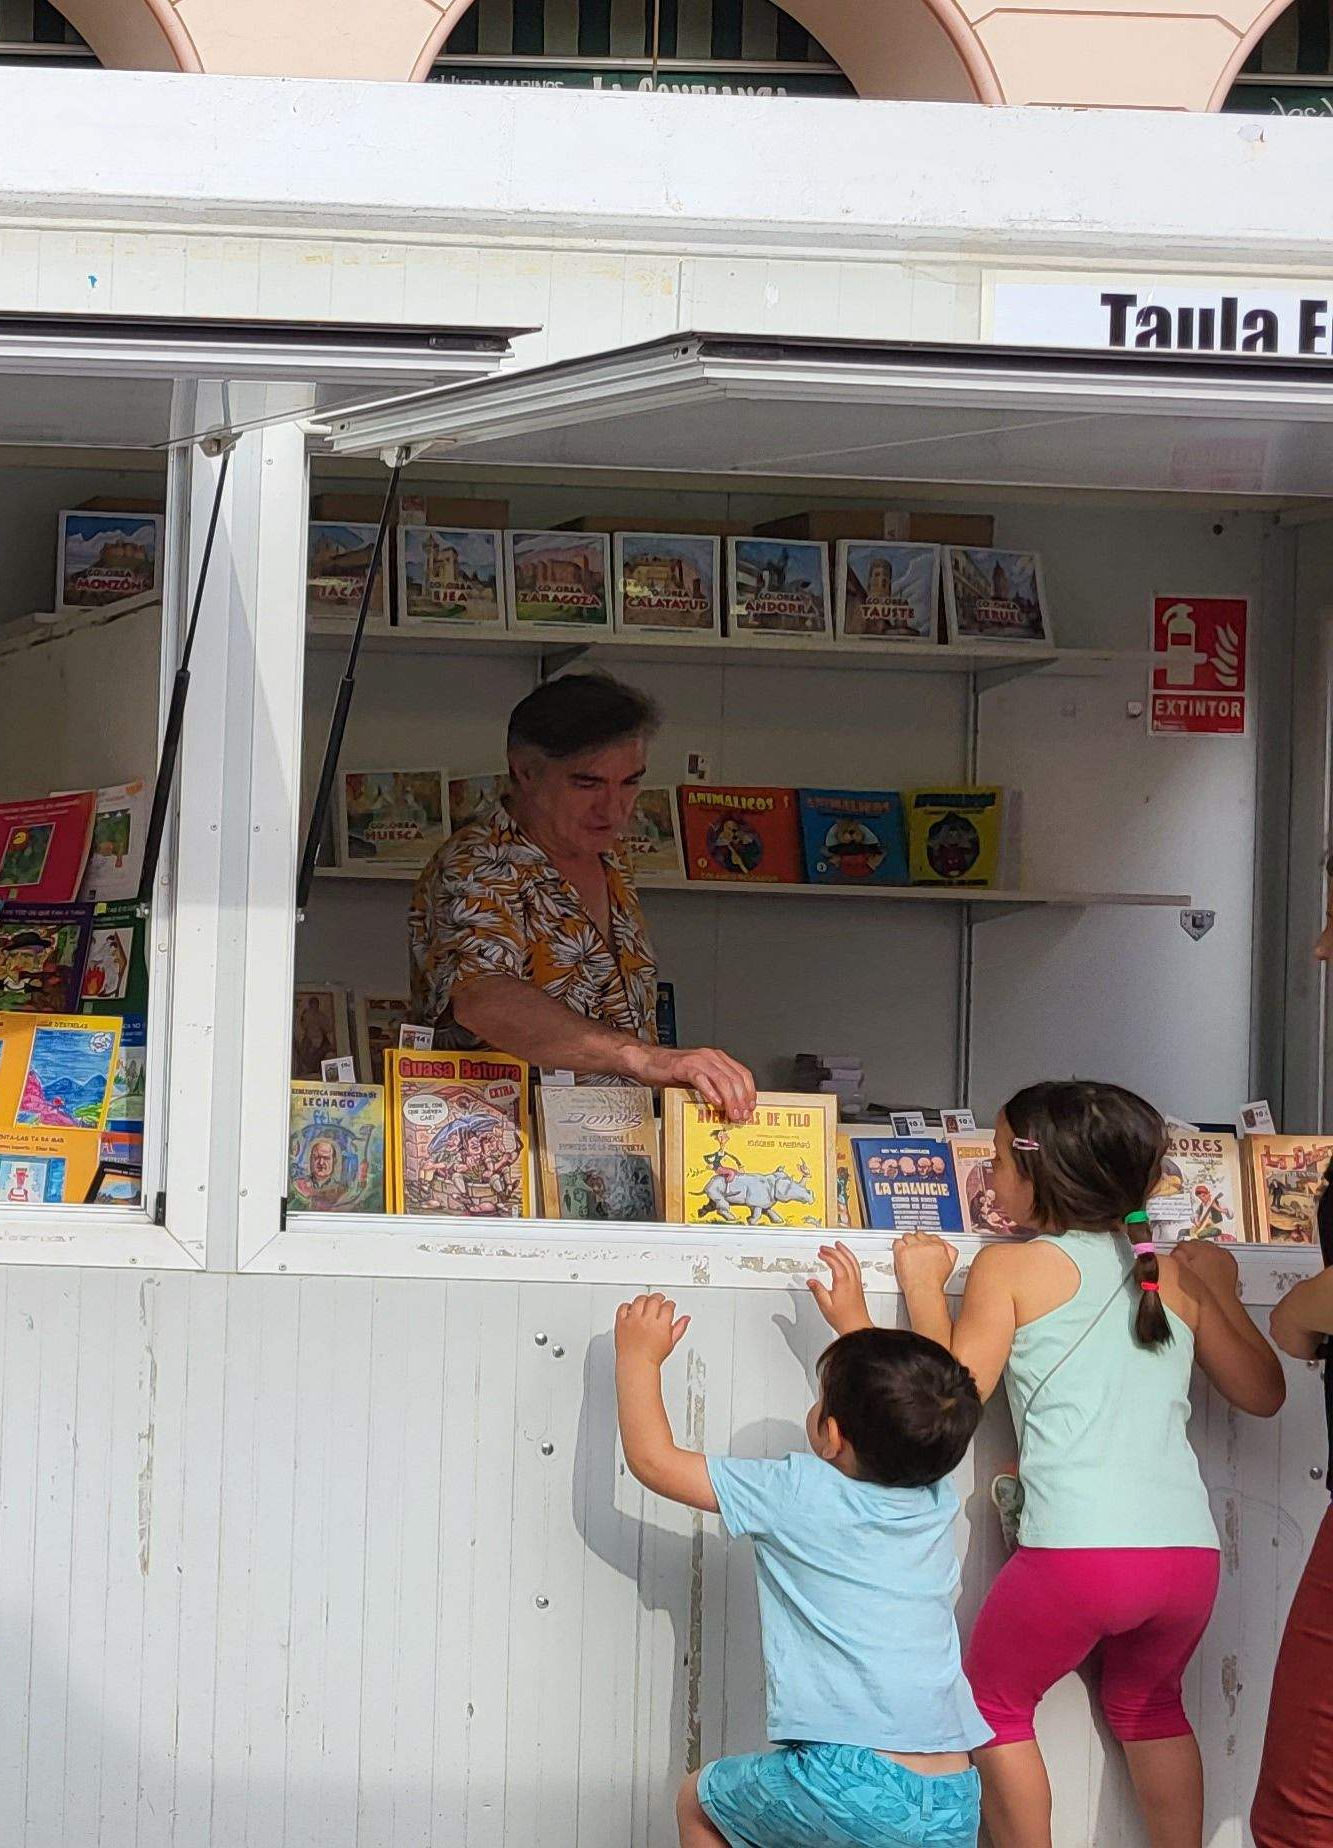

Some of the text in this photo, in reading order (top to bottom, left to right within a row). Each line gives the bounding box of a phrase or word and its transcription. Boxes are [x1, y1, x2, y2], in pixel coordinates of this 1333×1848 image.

[1100, 292, 1279, 353] Taula
[519, 592, 601, 606] ZARAGOZA
[627, 598, 709, 610] CALATAYUD
[744, 601, 817, 615] ANDORRA
[861, 607, 915, 619] TAUSTE
[1155, 698, 1241, 718] EXTINTOR
[687, 792, 774, 811] ANIMALICOS
[399, 1057, 521, 1082] Guasa Baturra
[488, 1086, 515, 1101] EXTRA
[302, 1097, 355, 1108] LECHAGO
[766, 1112, 781, 1127] DE
[786, 1112, 811, 1128] TILO
[874, 1182, 950, 1197] LA CALVICIE
